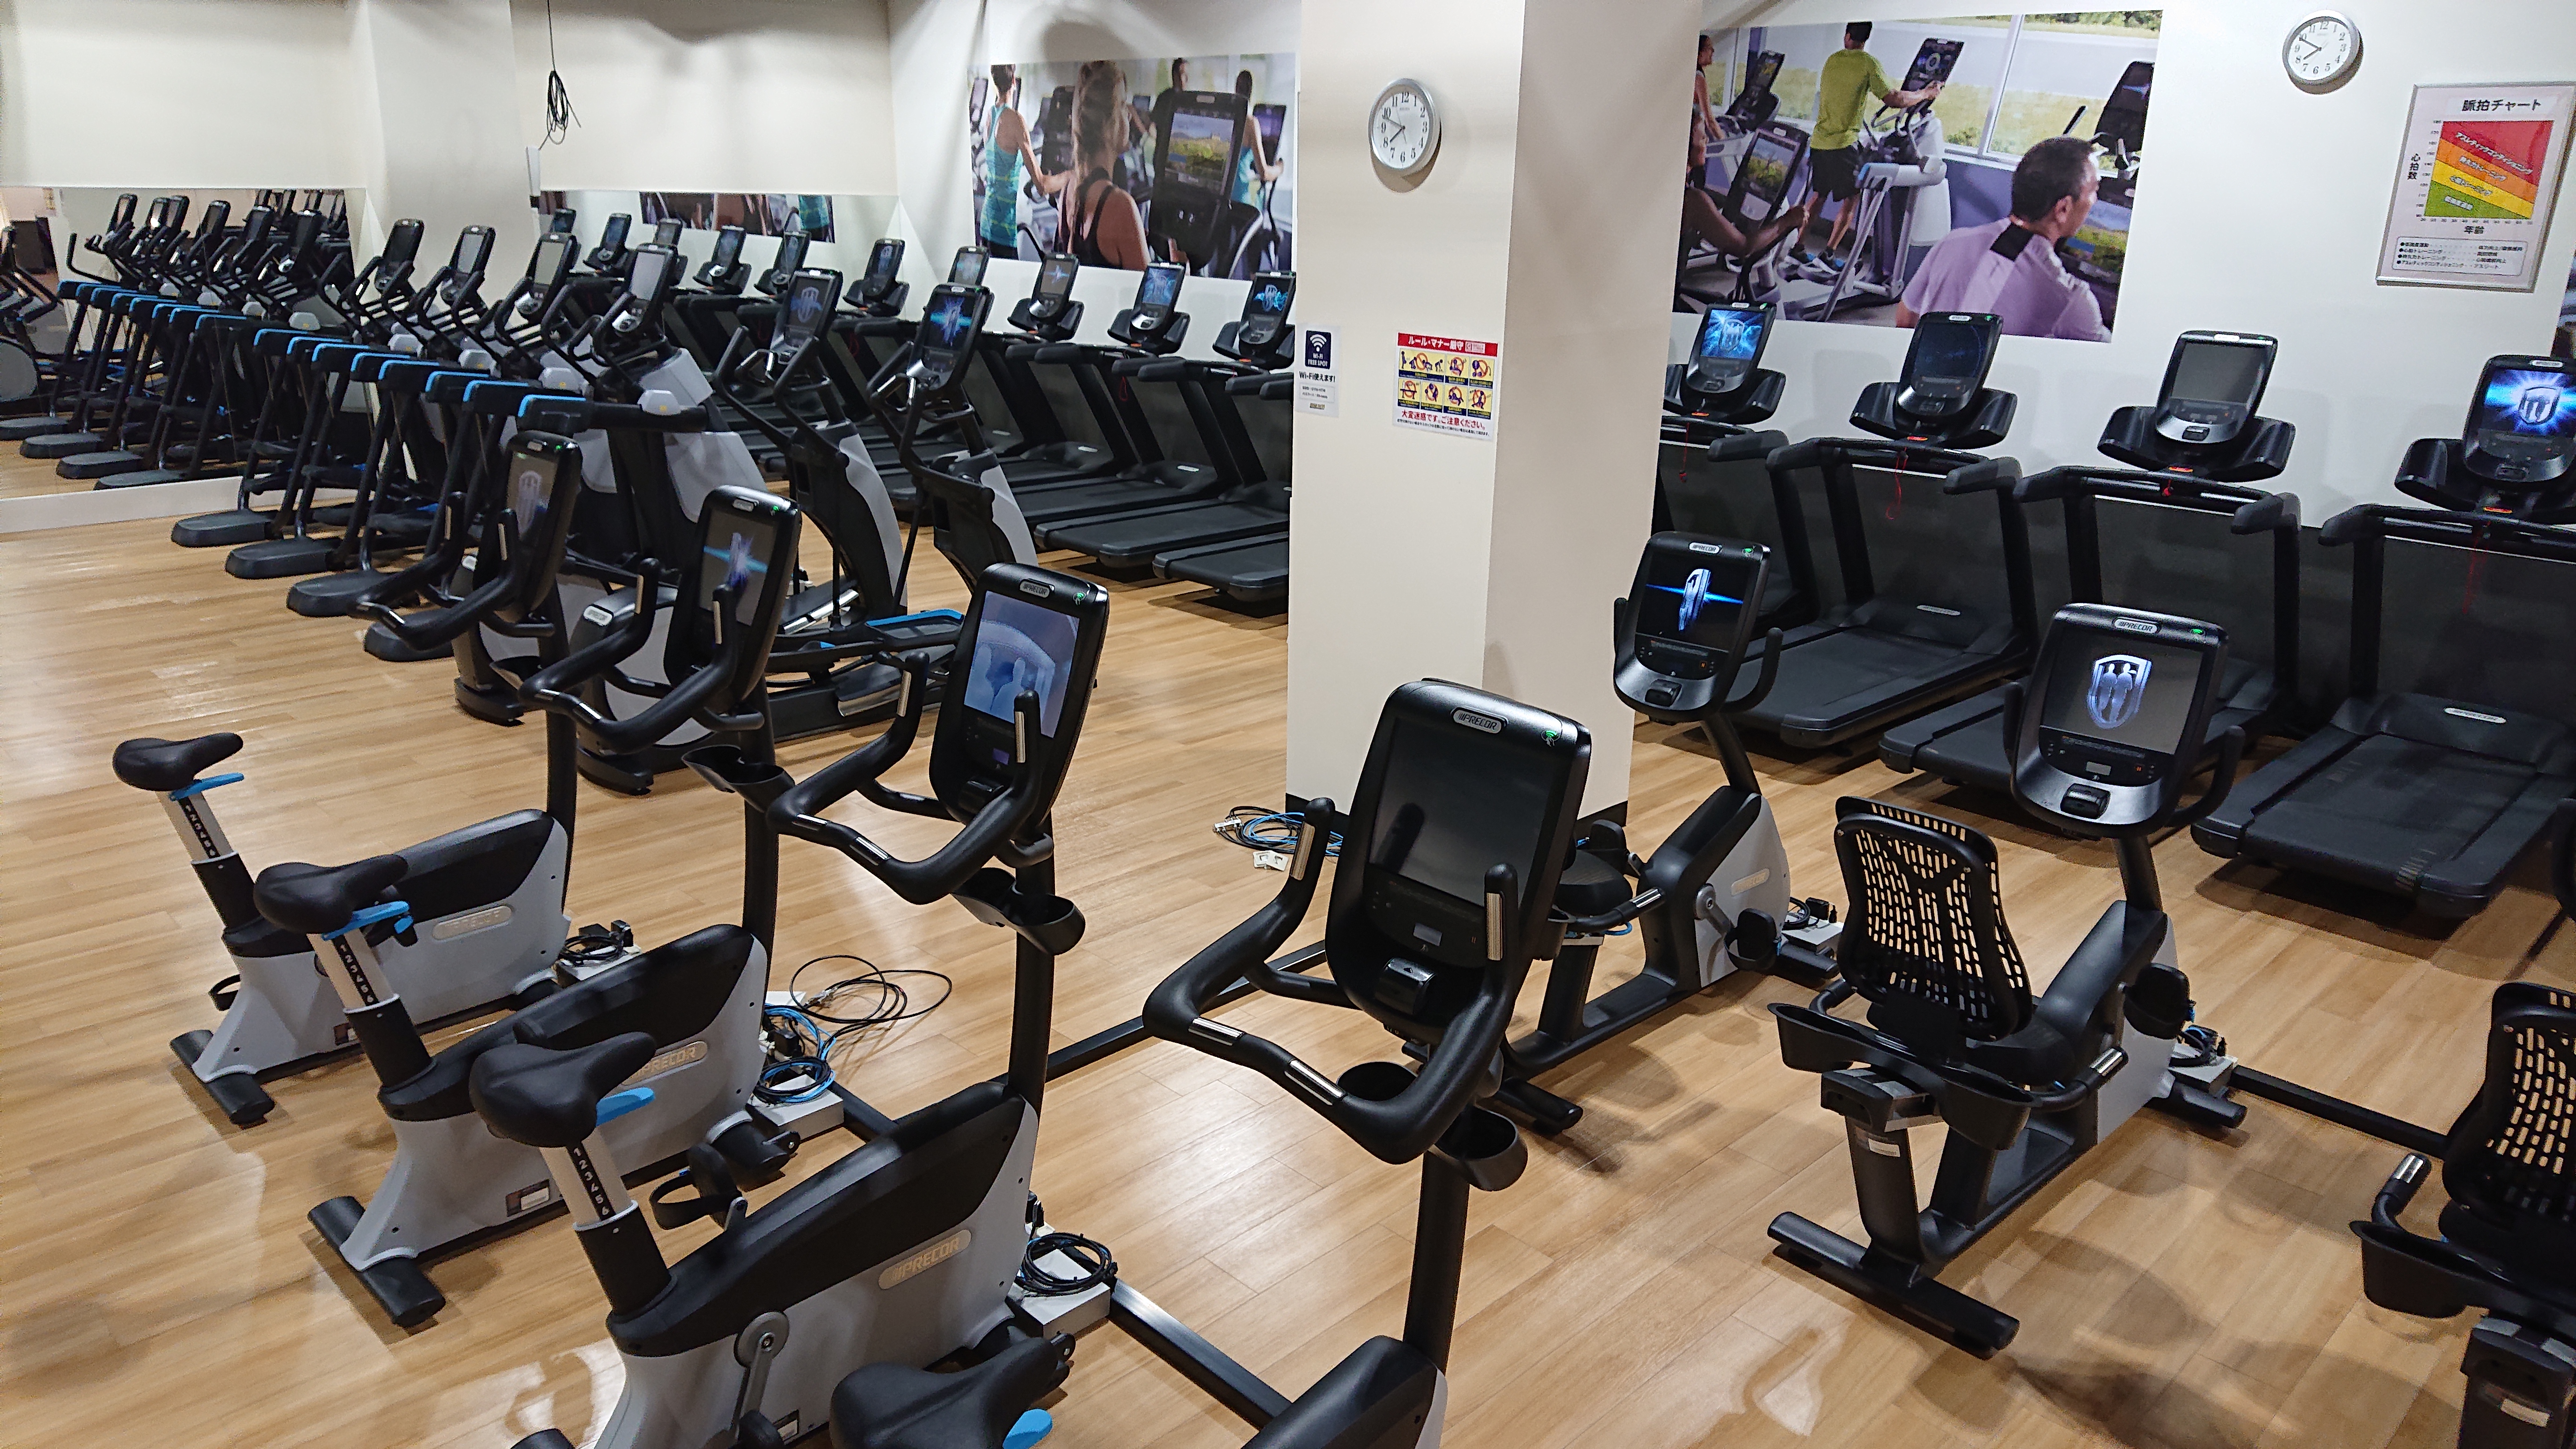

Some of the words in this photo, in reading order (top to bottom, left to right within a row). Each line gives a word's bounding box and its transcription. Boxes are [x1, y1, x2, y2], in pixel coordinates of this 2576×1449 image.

[2320, 21, 2329, 29] 12
[2339, 32, 2345, 41] 2
[2295, 55, 2301, 64] 8
[2303, 63, 2308, 72] 7
[2325, 63, 2330, 72] 5
[1392, 96, 1398, 107] 11
[1402, 92, 1409, 102] 12
[1414, 95, 1417, 106] 1
[2462, 99, 2541, 111] 脈拍チャート
[1420, 107, 1425, 118] 2
[1381, 122, 1386, 133] 9
[1422, 122, 1427, 133] 3
[1383, 137, 1389, 148] 8
[1419, 137, 1423, 148] 4
[1390, 147, 1395, 159] 7
[1400, 151, 1405, 163] 6
[1411, 148, 1416, 159] 5
[1402, 410, 1485, 430] 大変迷惑です。ご注意ください。
[1026, 585, 1047, 595] PRECOR
[2123, 622, 2153, 631] PRECOR
[1462, 713, 1497, 730] PRECOR
[345, 954, 353, 963] 2
[574, 1148, 581, 1156] 1
[578, 1160, 588, 1170] 2
[585, 1171, 593, 1181] 3
[591, 1182, 599, 1192] 4
[595, 1194, 603, 1204] 5
[602, 1206, 609, 1216] 6
[901, 1237, 959, 1277] PRECOR
